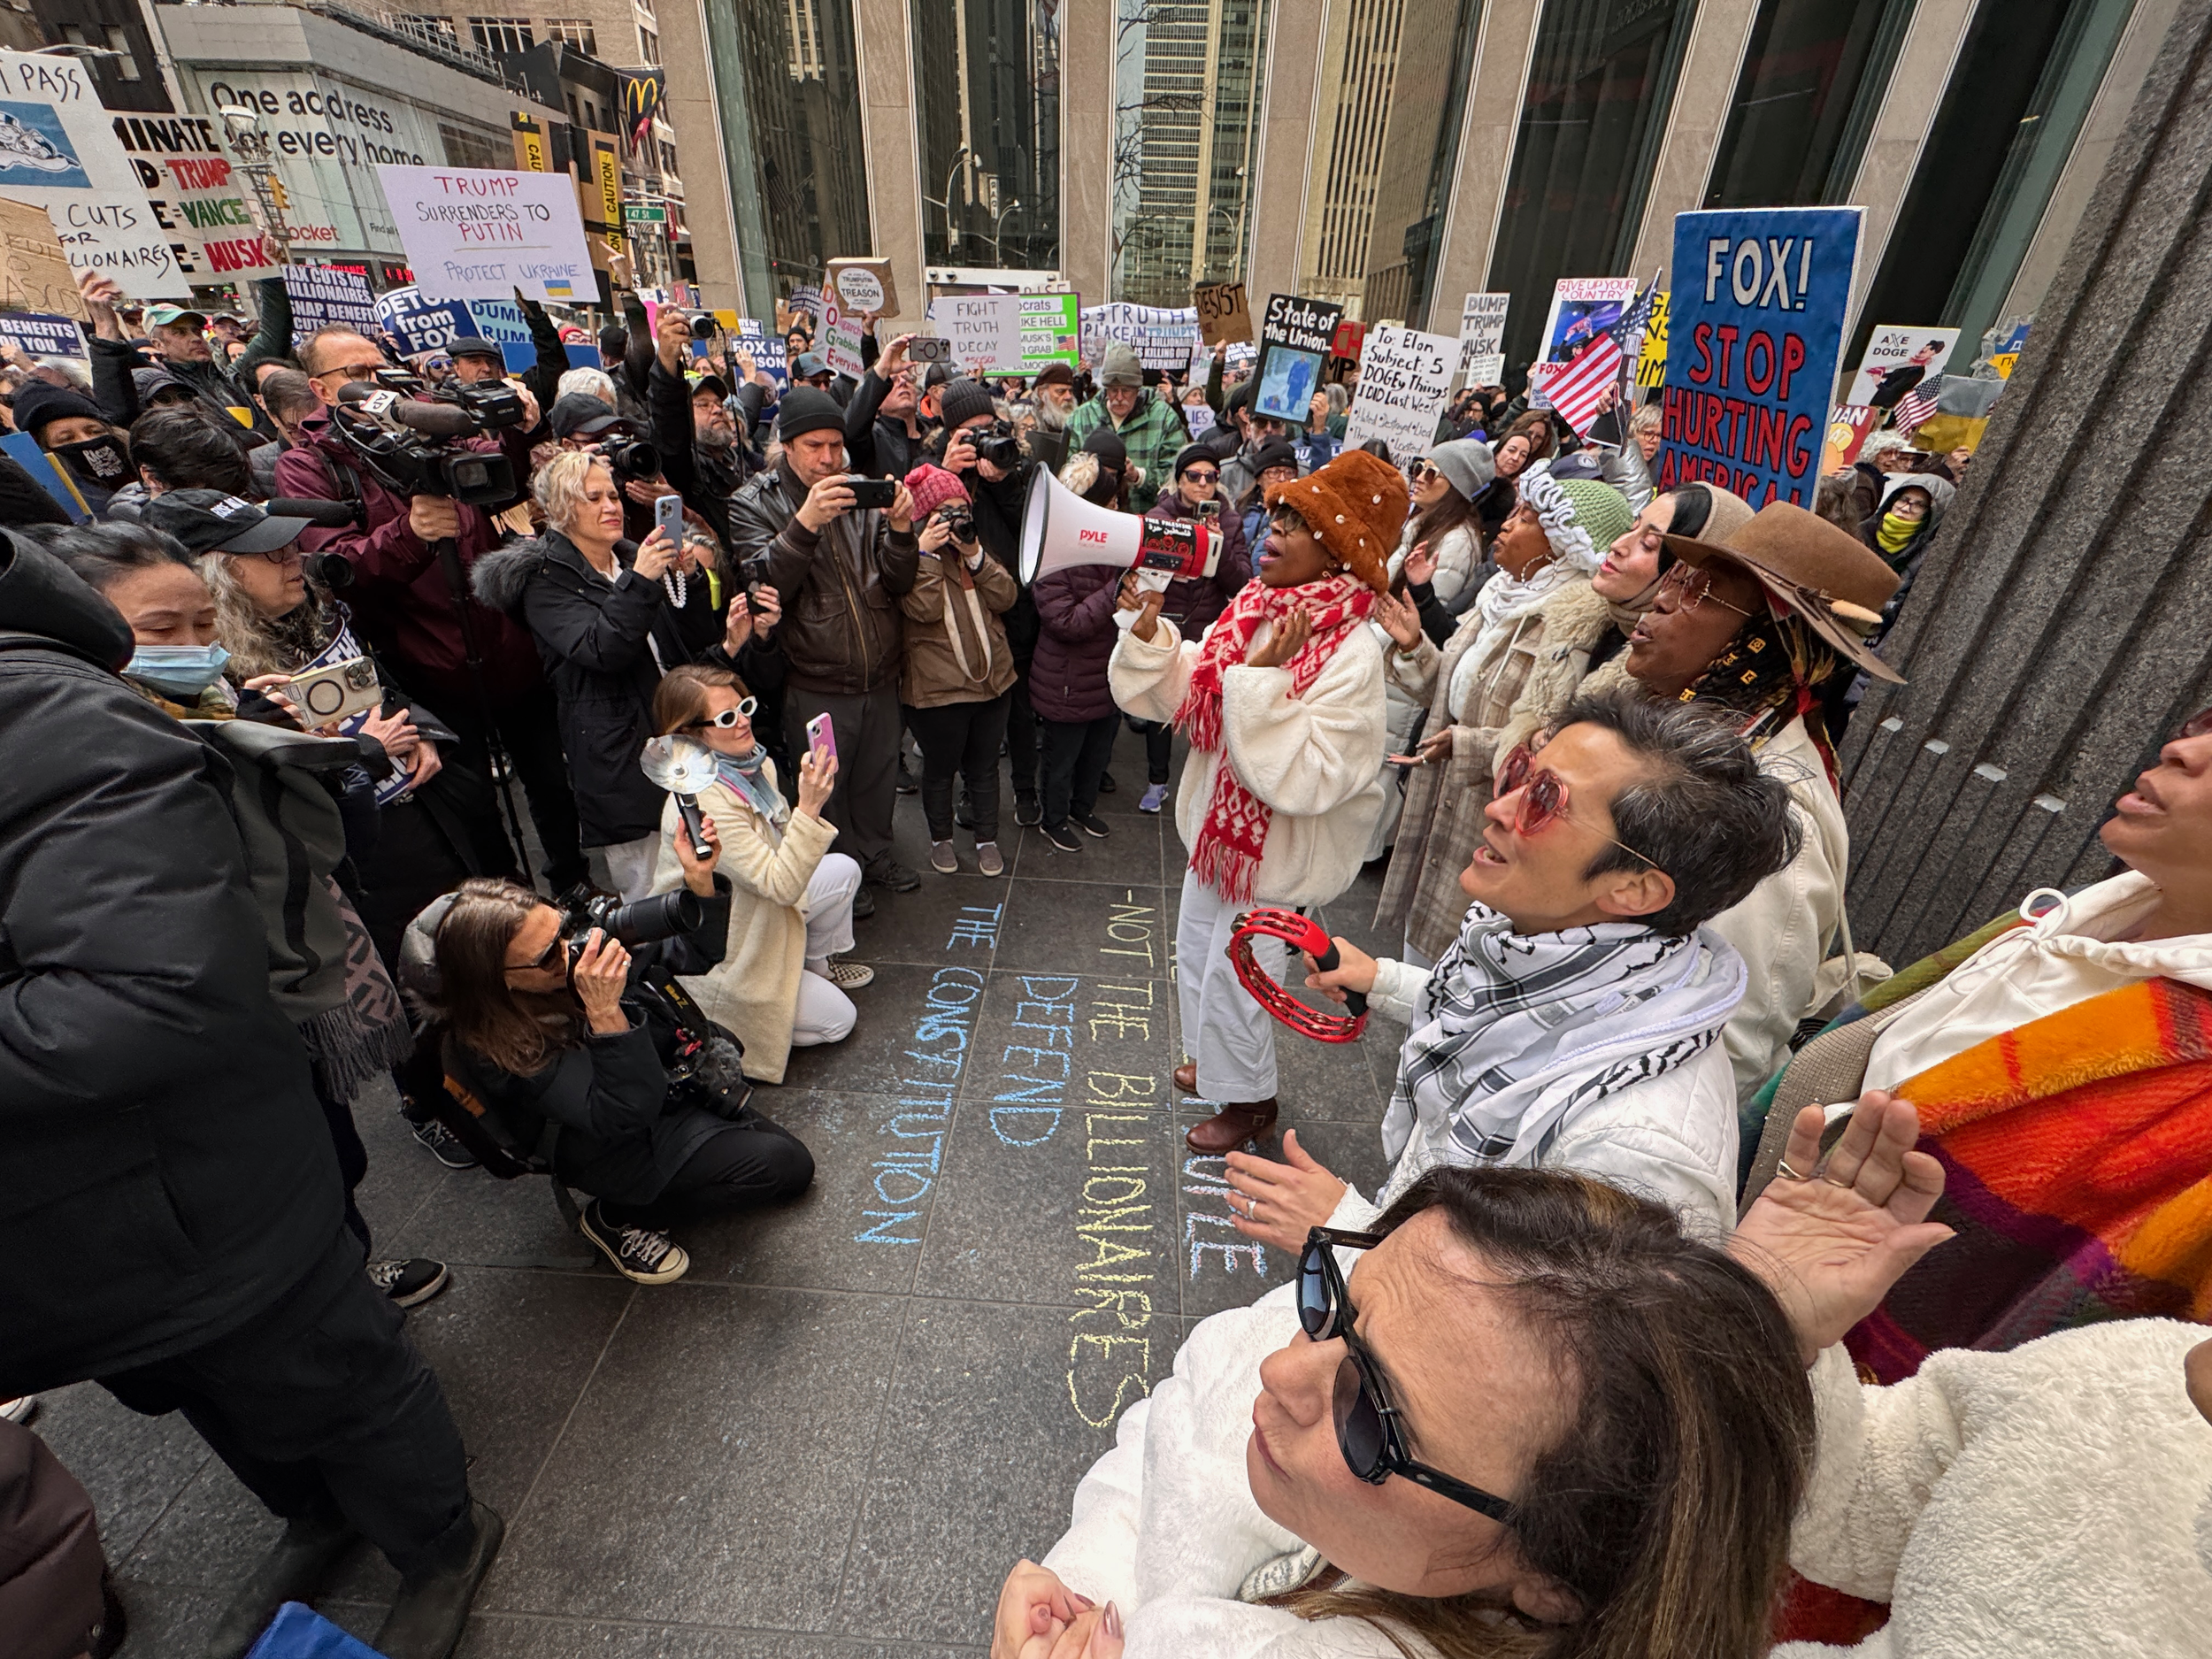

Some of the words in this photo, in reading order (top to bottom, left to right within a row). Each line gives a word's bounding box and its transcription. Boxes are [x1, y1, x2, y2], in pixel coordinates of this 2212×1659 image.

[19, 63, 81, 103] PASS
[211, 81, 280, 115] One
[278, 130, 358, 166] every
[164, 157, 232, 190] TRUMP
[434, 176, 519, 197] TRUMP
[602, 161, 618, 213] CAUTION
[67, 203, 138, 231] CUTS
[178, 197, 253, 229] VANCE
[416, 201, 518, 223] SURRENDERS
[523, 204, 550, 222] TO
[631, 210, 640, 219] 47
[641, 210, 650, 219] St
[58, 232, 100, 249] FOR
[458, 222, 524, 242] PUTIN
[203, 237, 274, 273] MUSK
[280, 264, 310, 283] TAX
[310, 265, 348, 288] CUTS
[347, 273, 367, 290] for
[443, 260, 507, 282] PROTECT
[520, 263, 580, 281] UKRAINE
[1705, 235, 1814, 312] FOX!
[841, 288, 880, 298] TREASON
[1557, 280, 1586, 292] GIVE
[1586, 280, 1602, 290] UP
[1602, 280, 1636, 291] YOUR
[1562, 290, 1625, 300] COUNTRY
[956, 302, 999, 317] FIGHT
[1195, 282, 1243, 319] RESIST
[1467, 296, 1508, 312] DUMP
[396, 309, 456, 334] from
[1039, 316, 1065, 326] HELL
[1107, 303, 1186, 326] TRUTH
[1268, 297, 1317, 328] State
[1318, 311, 1339, 331] of
[1463, 314, 1505, 331] TRUMP
[408, 324, 460, 352] FOX
[952, 321, 1000, 334] TRUTH
[1084, 323, 1130, 342] PLACE
[1264, 322, 1287, 342] the
[732, 340, 768, 355] FOX
[770, 342, 785, 356] is
[957, 340, 999, 353] DECAY
[1027, 345, 1052, 354] GRAB
[1132, 336, 1150, 347] THIS
[1378, 326, 1397, 346] To:
[1402, 332, 1433, 353] Elon
[1880, 333, 1910, 348] AXE
[1144, 348, 1175, 358] KILLING
[1175, 348, 1190, 358] OUR
[1368, 345, 1425, 373] Subject:
[1429, 357, 1444, 374] 5
[1688, 321, 1807, 402] STOP
[1872, 347, 1909, 357] DOGE
[1363, 364, 1406, 392] DOGEy
[1409, 374, 1449, 400] Things
[373, 392, 389, 411] AP
[1357, 384, 1364, 397] I
[1365, 387, 1385, 403] DID
[1384, 390, 1408, 410] Last
[1661, 382, 1814, 479] HURTING
[1079, 529, 1109, 543] PYLE
[946, 902, 1003, 950] THE
[1088, 979, 1153, 1042] THE
[989, 975, 1079, 1148] DEFEND
[1067, 1071, 1156, 1427] BILLIONAIRES
